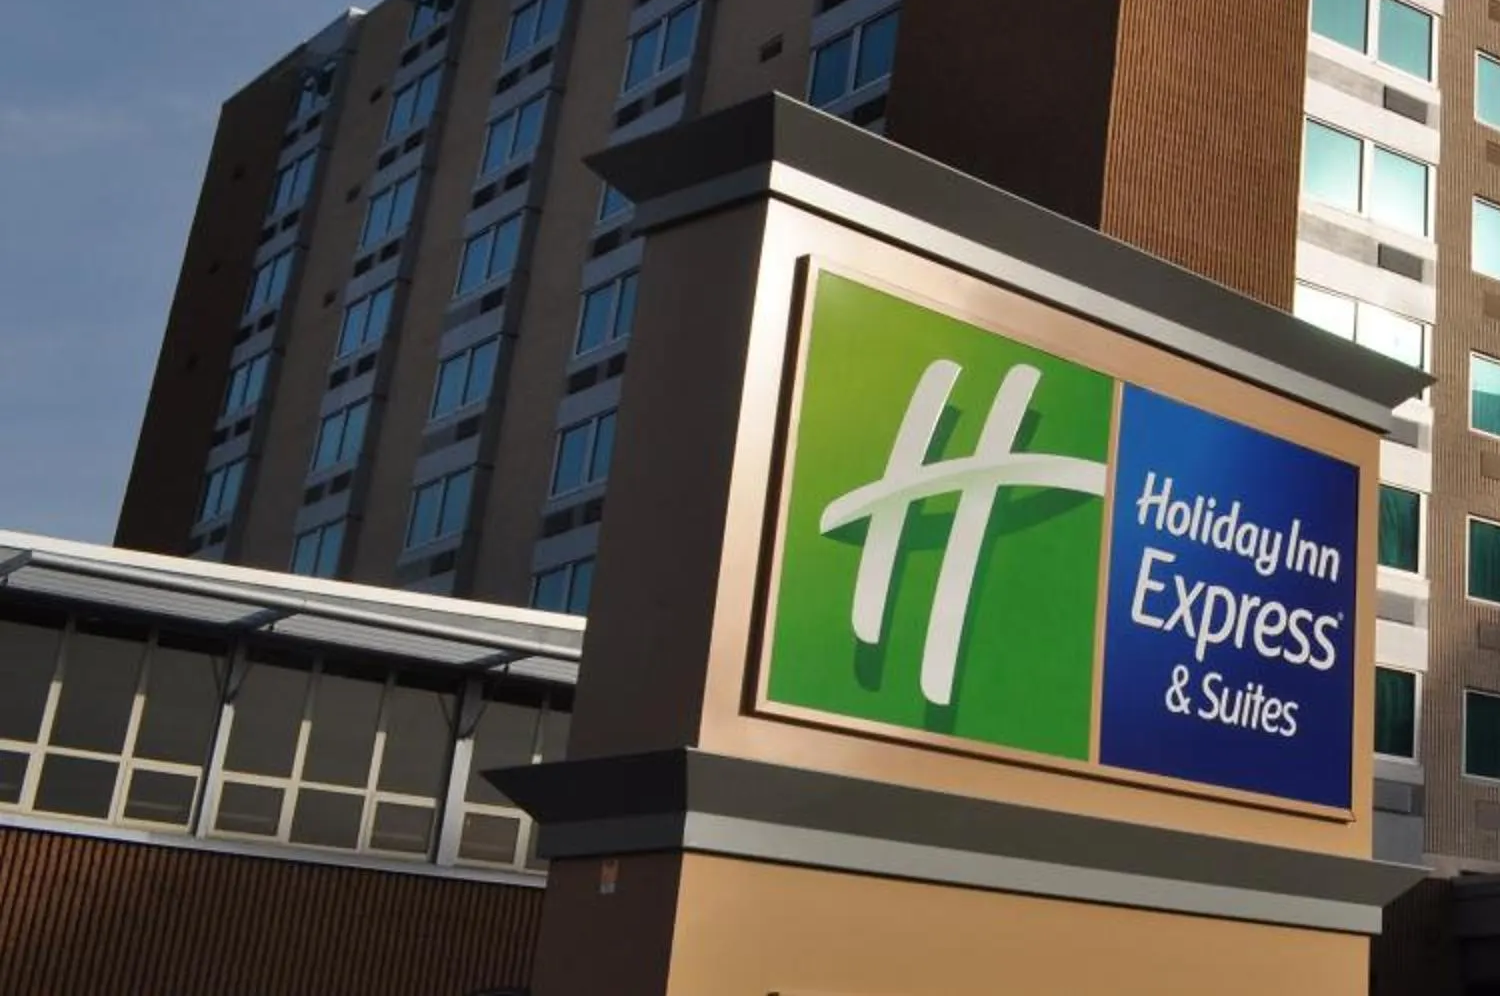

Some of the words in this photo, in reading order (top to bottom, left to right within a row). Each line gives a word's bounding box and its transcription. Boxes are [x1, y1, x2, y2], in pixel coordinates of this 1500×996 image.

[819, 359, 1107, 705] H
[1136, 471, 1282, 576] Holiday
[1286, 518, 1340, 583] Inn
[1131, 546, 1338, 671] Express
[1165, 664, 1191, 715] &
[1198, 672, 1299, 737] Suites
